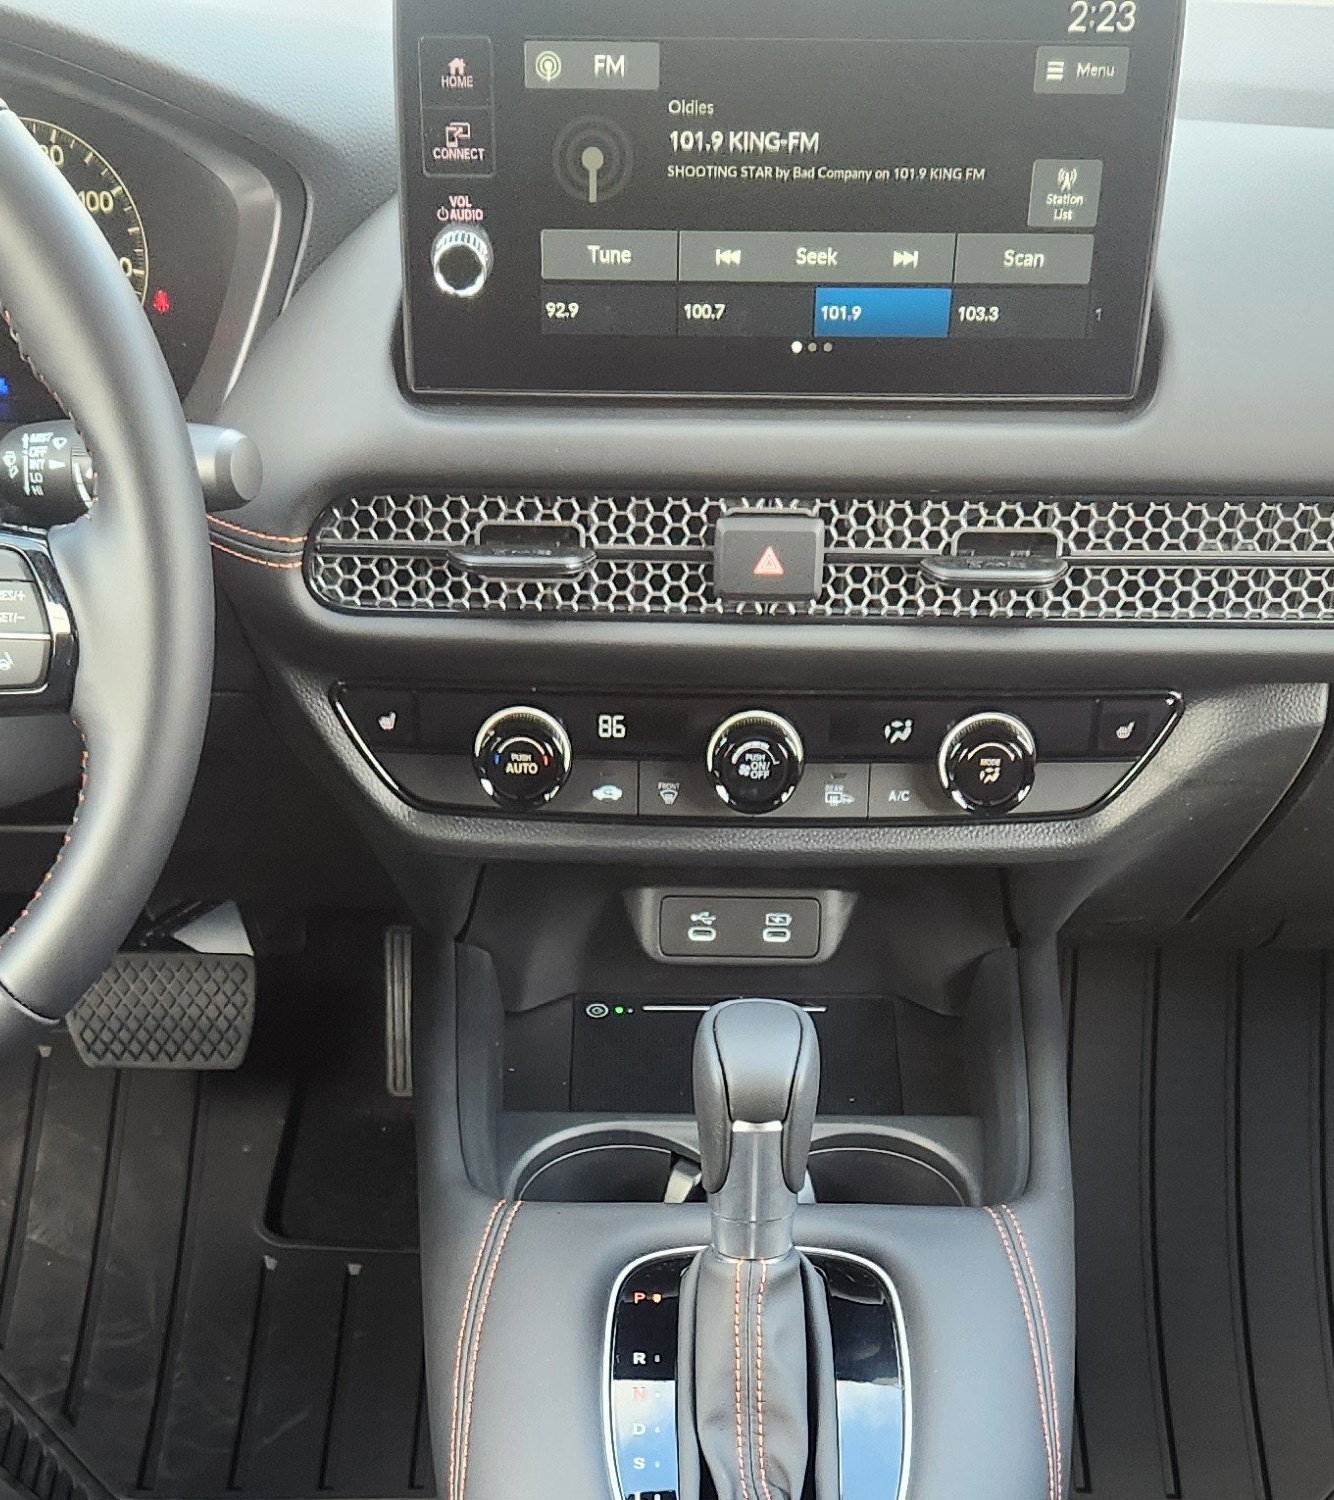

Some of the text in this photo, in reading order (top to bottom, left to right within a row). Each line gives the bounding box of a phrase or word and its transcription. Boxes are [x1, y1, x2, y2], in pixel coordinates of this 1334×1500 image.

[1068, 0, 1137, 33] 2:23
[594, 55, 625, 77] FM
[1077, 63, 1115, 78] Menu
[441, 76, 473, 88] HOME
[669, 100, 713, 115] Oldies
[669, 131, 819, 153] 101.9 KING-FM
[433, 148, 485, 160] CONNECT
[667, 165, 986, 182] SHOOTING STAR by Bad Company on 101.9 KING FM
[78, 191, 113, 213] 100
[449, 195, 472, 208] VOL
[1046, 194, 1083, 206] Station
[450, 209, 483, 221] AUDIO
[1054, 209, 1073, 221] List
[587, 245, 632, 265] Tune
[796, 247, 838, 266] Seek
[1003, 249, 1044, 268] Scan
[545, 302, 579, 319] 92.9
[684, 304, 726, 320] 100.7
[821, 305, 862, 321] 101.9
[958, 306, 999, 322] 103.3
[29, 445, 48, 458] OFF
[29, 458, 46, 471] INT
[29, 472, 43, 484] LO
[598, 714, 626, 738] 86
[511, 753, 531, 762] PUSH
[745, 753, 766, 762] PUSH
[505, 762, 538, 775] AUTO
[750, 770, 770, 780] OFF
[888, 789, 911, 802] A/C
[633, 1292, 646, 1304] P
[633, 1352, 647, 1366] R
[632, 1387, 647, 1400] N
[633, 1423, 646, 1436] D
[633, 1457, 646, 1470] S
